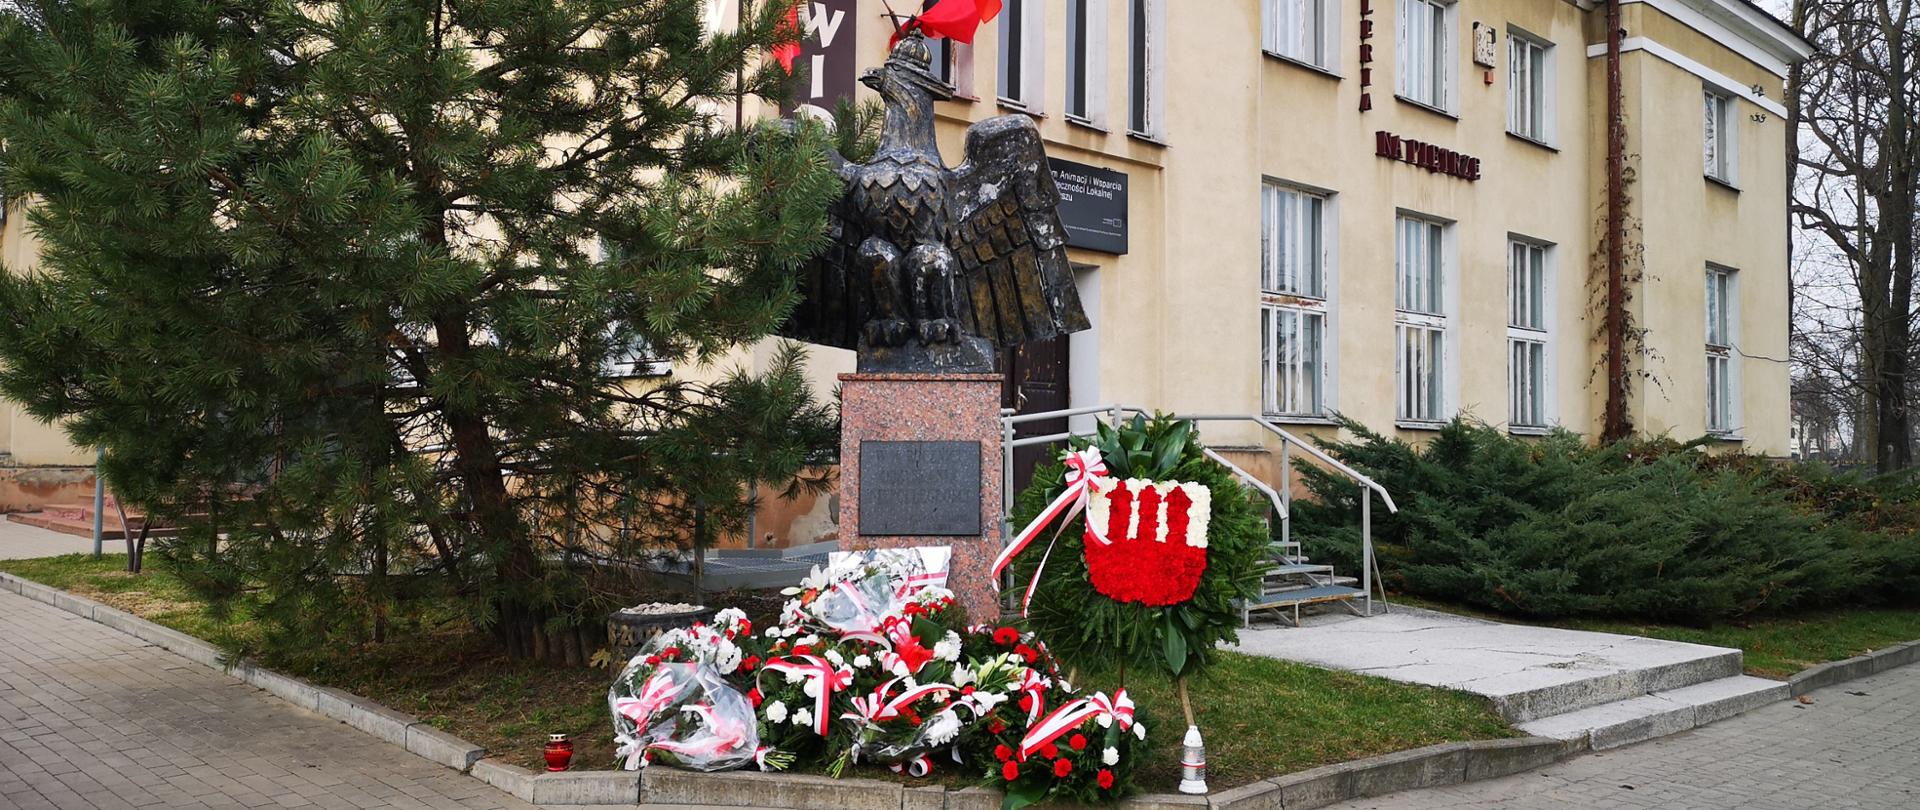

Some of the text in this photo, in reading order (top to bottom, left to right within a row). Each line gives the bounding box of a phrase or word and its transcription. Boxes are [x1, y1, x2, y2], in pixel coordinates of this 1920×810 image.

[1375, 131, 1481, 182] NA PIĘTRZE
[1092, 176, 1122, 191] Wsparcia
[1086, 186, 1112, 200] Lokalnej
